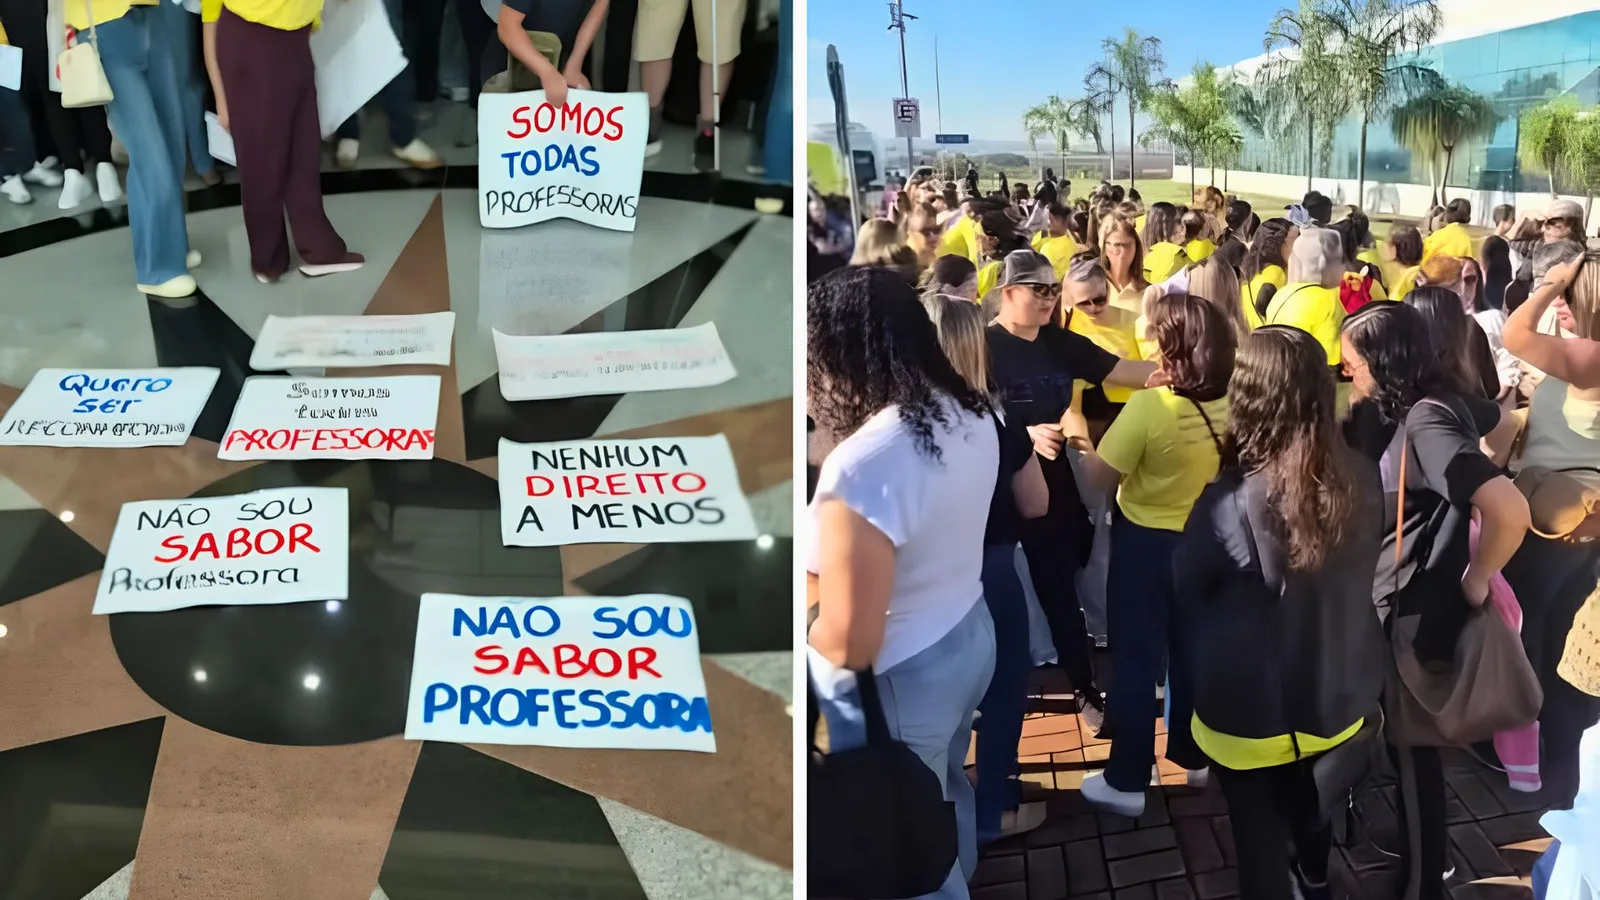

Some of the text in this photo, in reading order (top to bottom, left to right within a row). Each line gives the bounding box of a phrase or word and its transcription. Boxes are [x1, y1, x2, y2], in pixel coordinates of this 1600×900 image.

[507, 101, 624, 141] SOMOS
[501, 144, 600, 178] TODAS
[485, 185, 637, 218] PROFESSORAS
[532, 443, 688, 470] NENHUM
[525, 471, 707, 498] DIREITO
[137, 497, 313, 530] NÃO SOU
[516, 497, 725, 533] A MENOS
[154, 523, 321, 563] SABOR
[592, 606, 692, 639] SOU
[473, 644, 663, 679] SABOR
[423, 682, 713, 732] PROFESSORA
